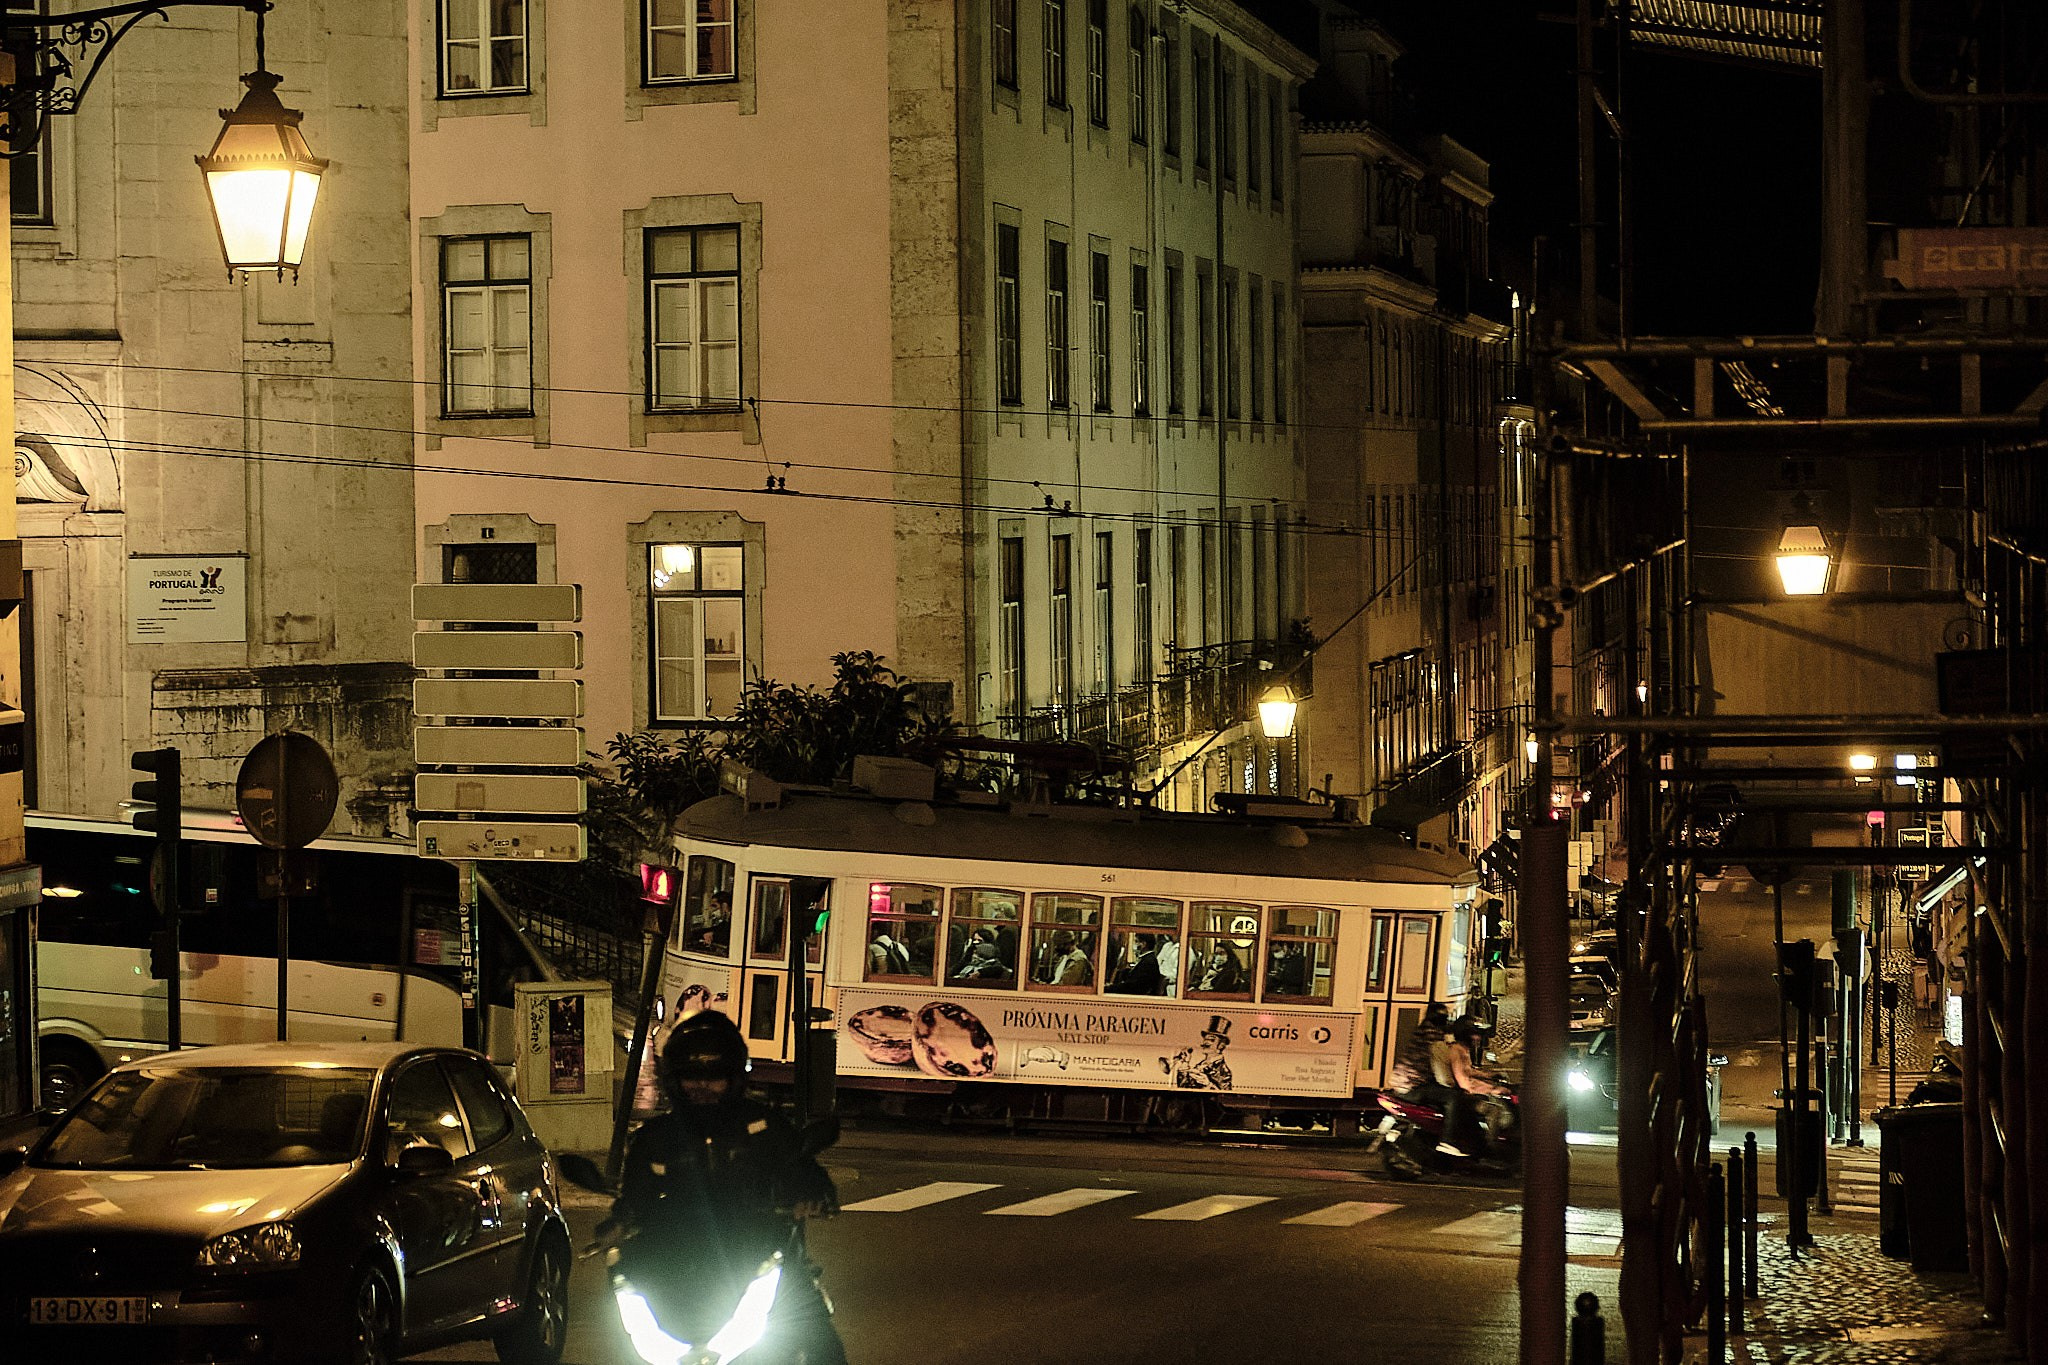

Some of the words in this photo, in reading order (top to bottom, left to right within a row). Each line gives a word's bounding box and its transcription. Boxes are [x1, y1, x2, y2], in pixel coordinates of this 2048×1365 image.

[153, 570, 182, 578] TURISMO
[149, 580, 198, 589] PORTUGAL
[1101, 874, 1116, 883] 561
[1002, 1008, 1080, 1031] PRÓXIMA
[1086, 1014, 1166, 1035] PARAGEM
[1249, 1023, 1299, 1041] carris
[1057, 1032, 1082, 1044] NEXT
[1085, 1034, 1110, 1045] STOP
